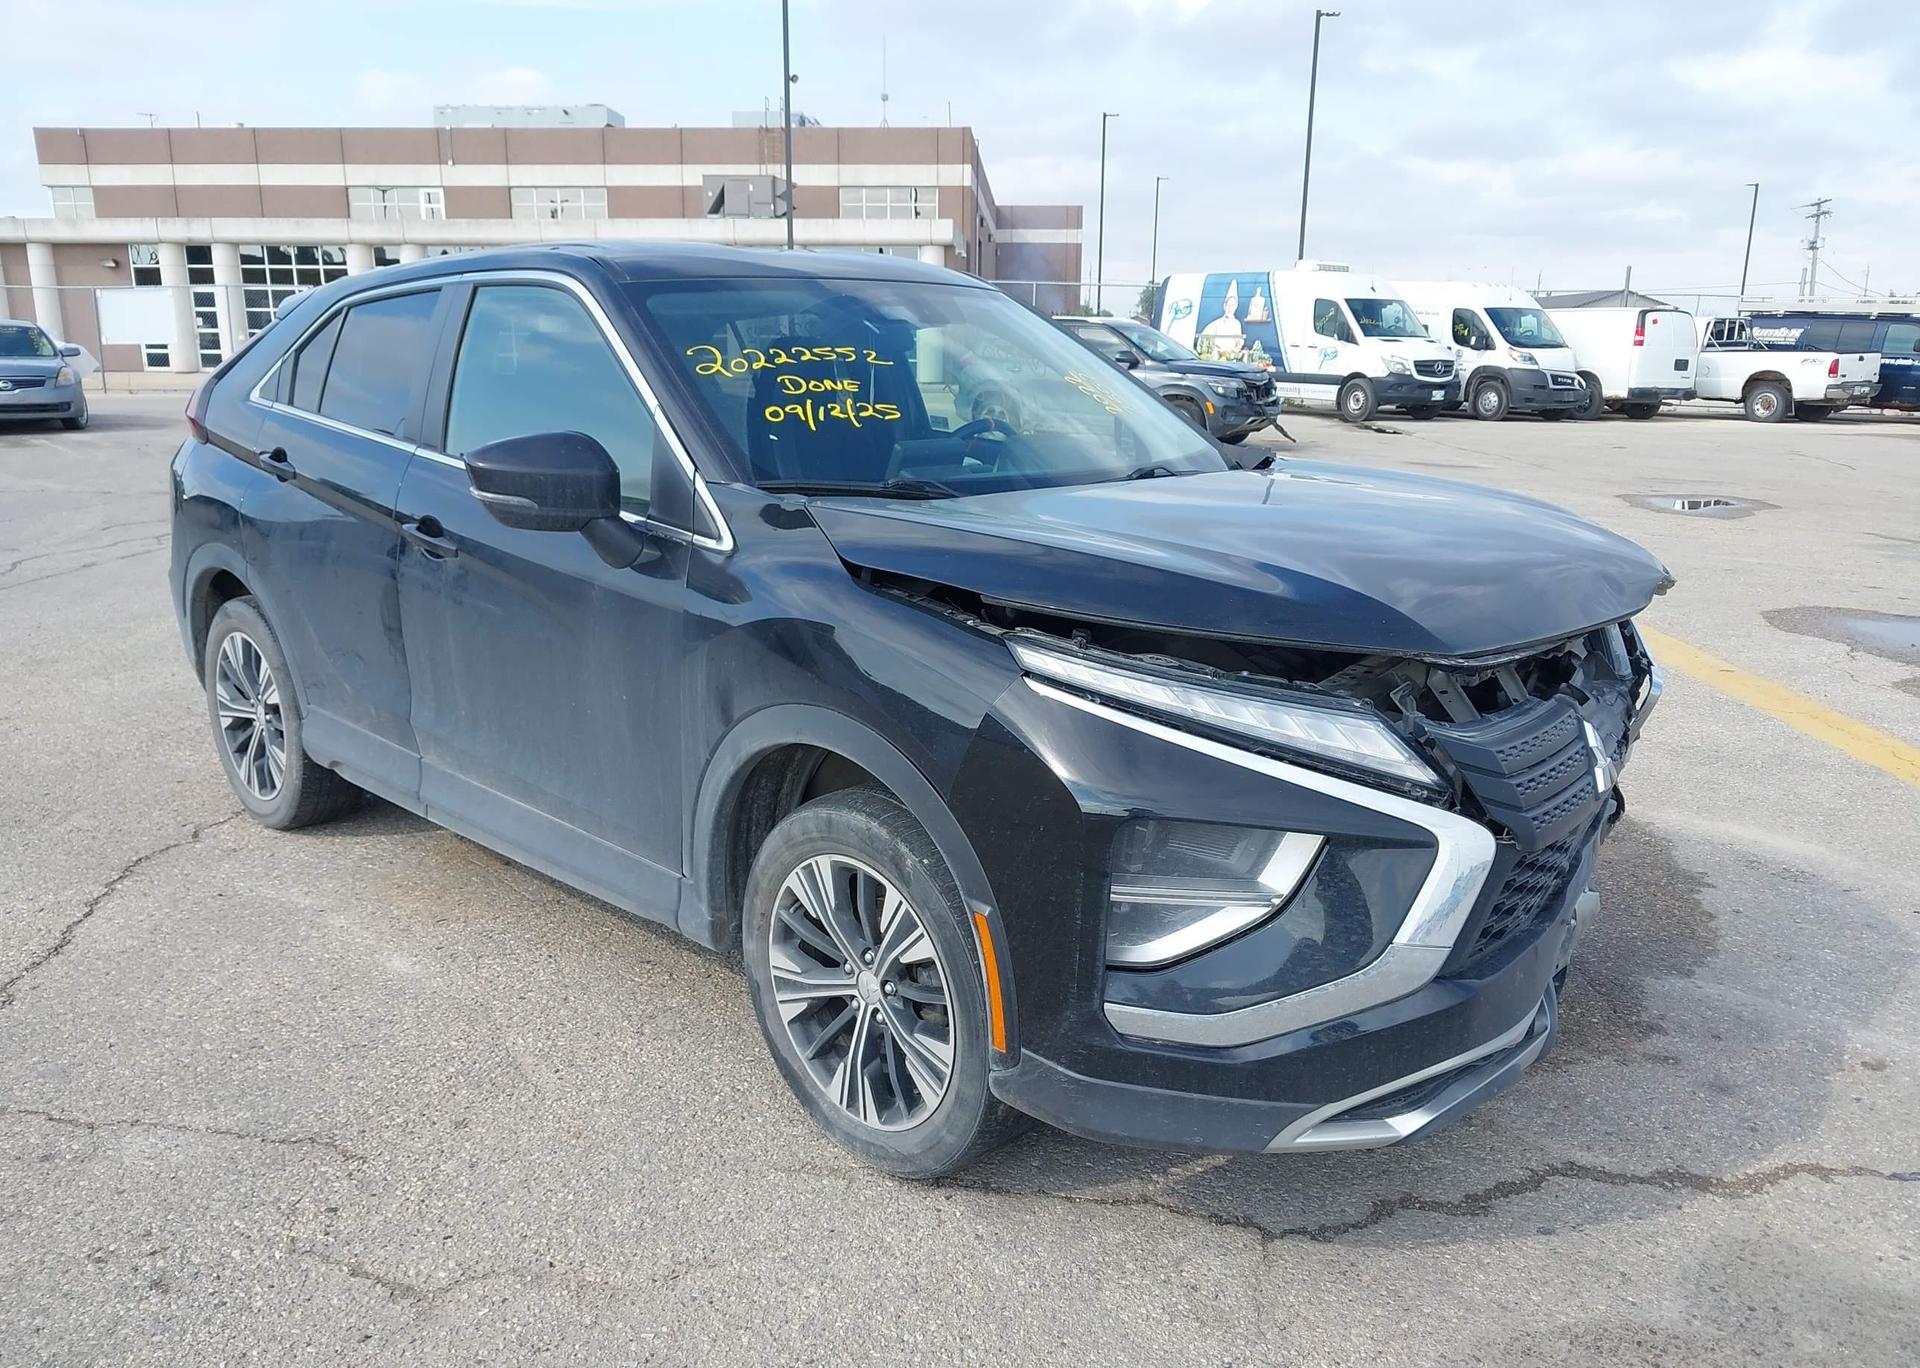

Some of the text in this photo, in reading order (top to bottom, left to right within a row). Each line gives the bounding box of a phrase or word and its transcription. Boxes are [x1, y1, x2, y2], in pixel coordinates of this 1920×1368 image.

[686, 345, 895, 377] 20222552
[777, 375, 861, 394] DONE
[765, 398, 902, 431] 09/12/25
